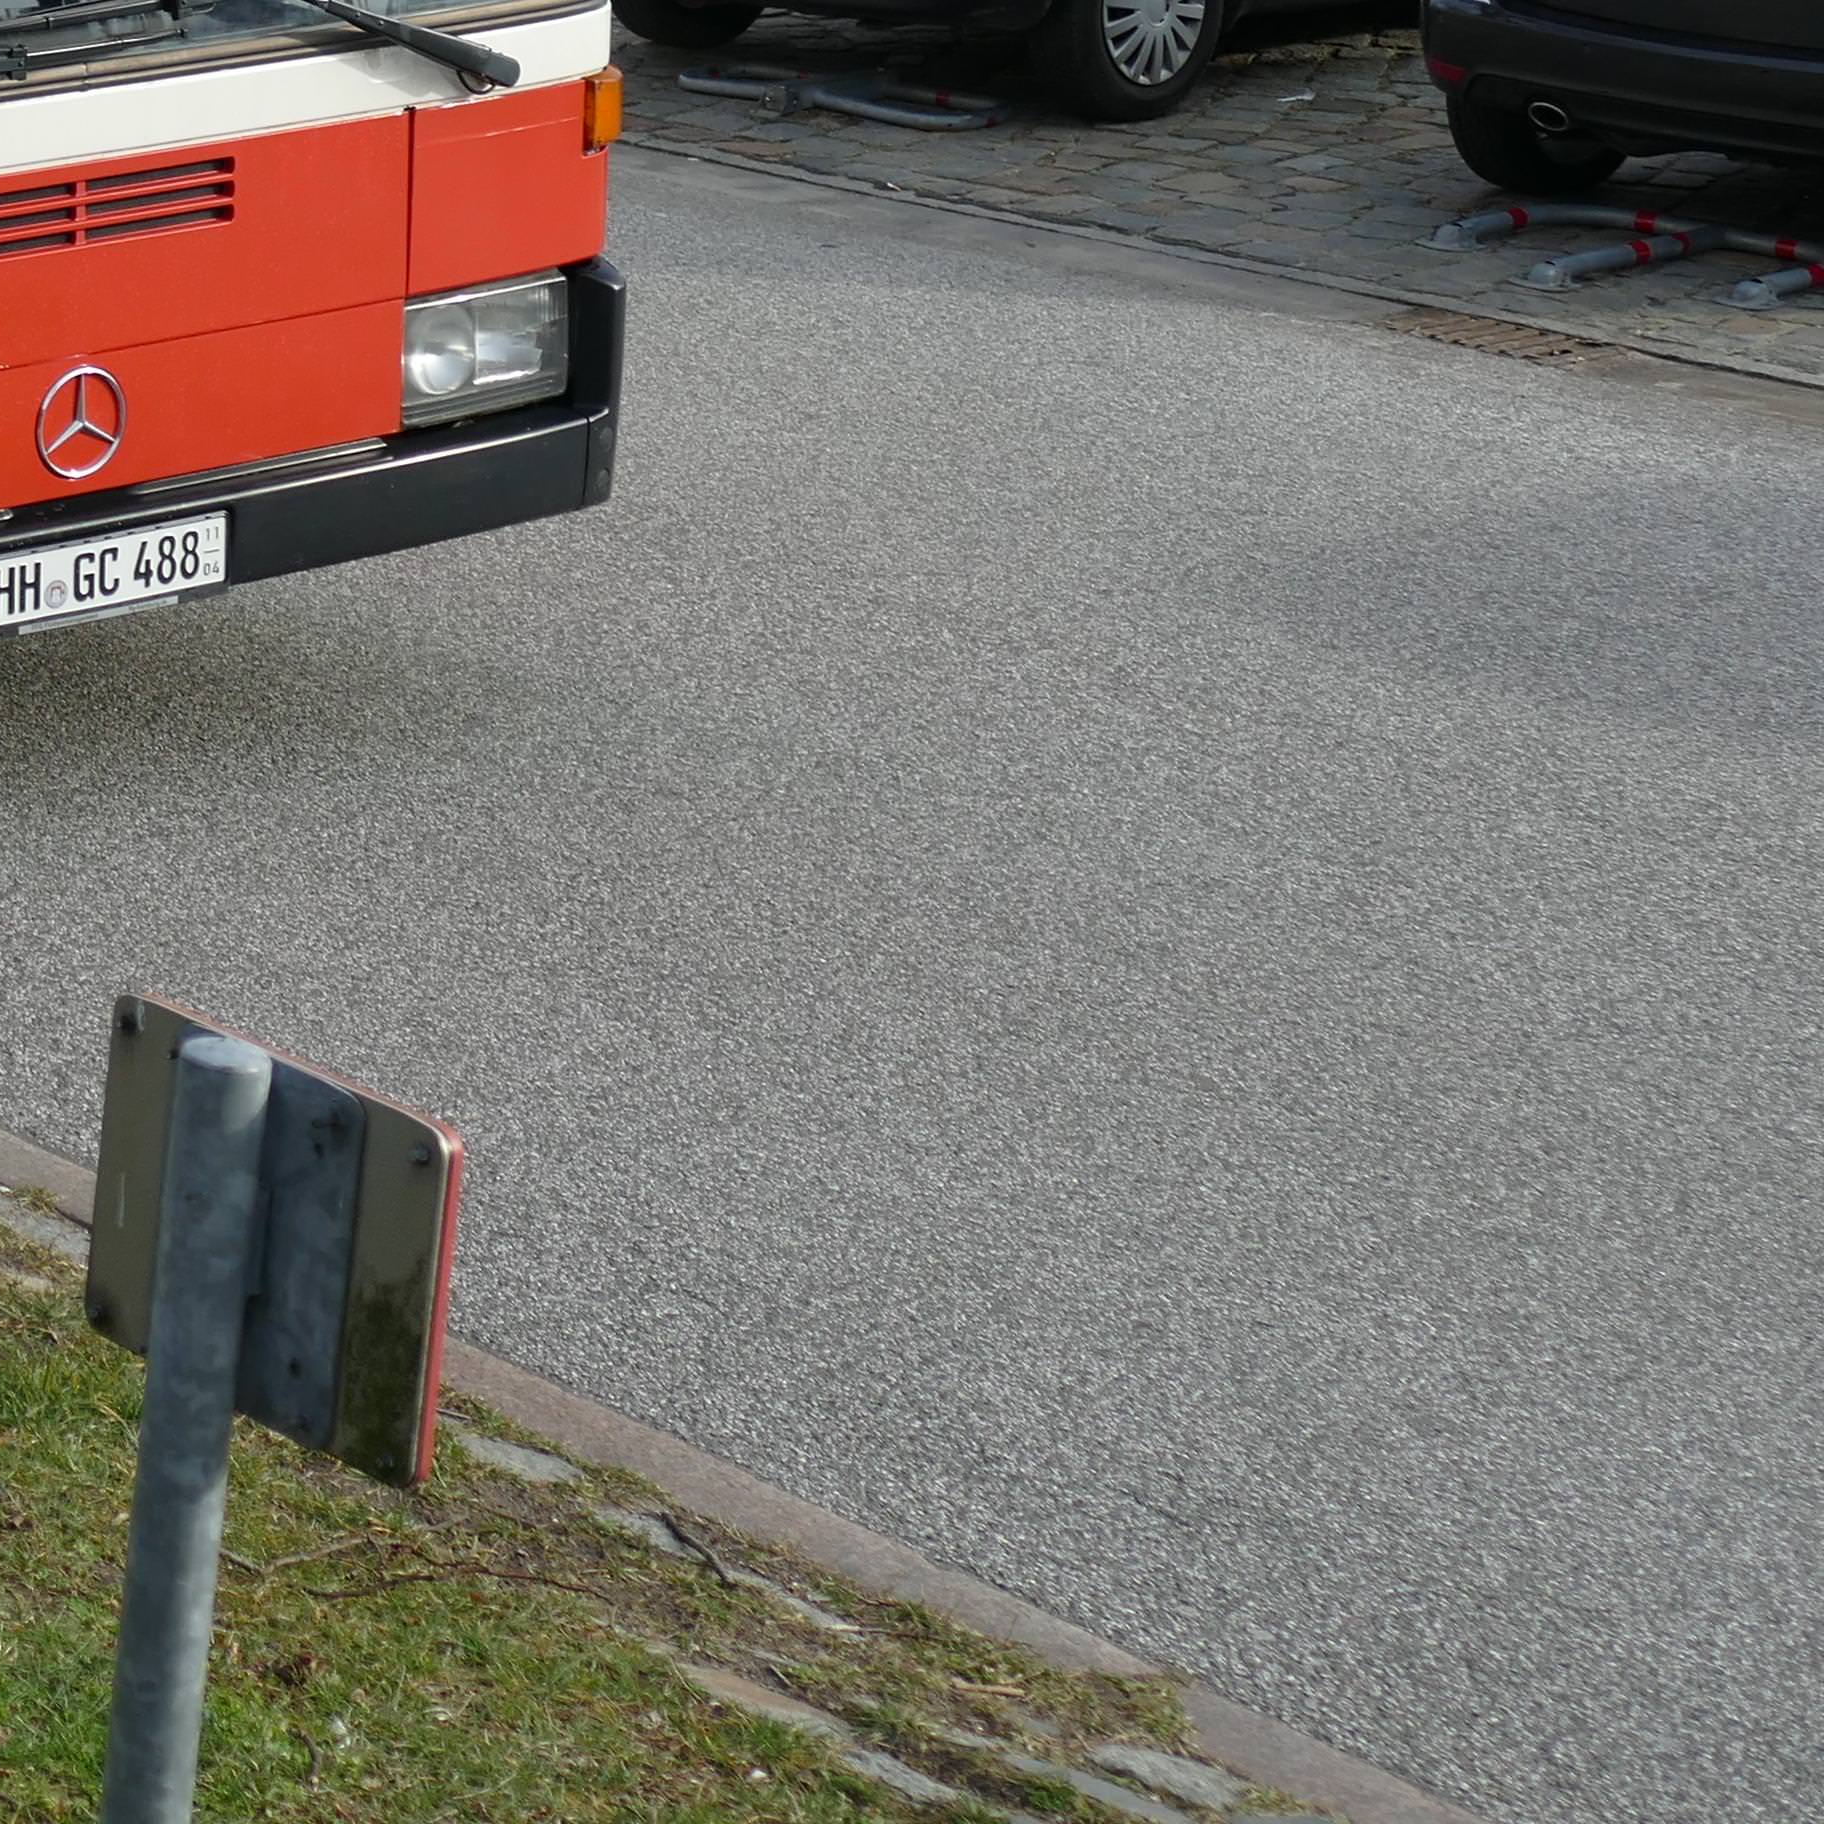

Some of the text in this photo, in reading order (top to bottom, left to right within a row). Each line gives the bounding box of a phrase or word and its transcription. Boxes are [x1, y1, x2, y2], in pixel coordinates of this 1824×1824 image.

[205, 526, 221, 542] 11
[73, 546, 120, 602] GC
[133, 529, 201, 588] 488
[202, 560, 221, 577] 04
